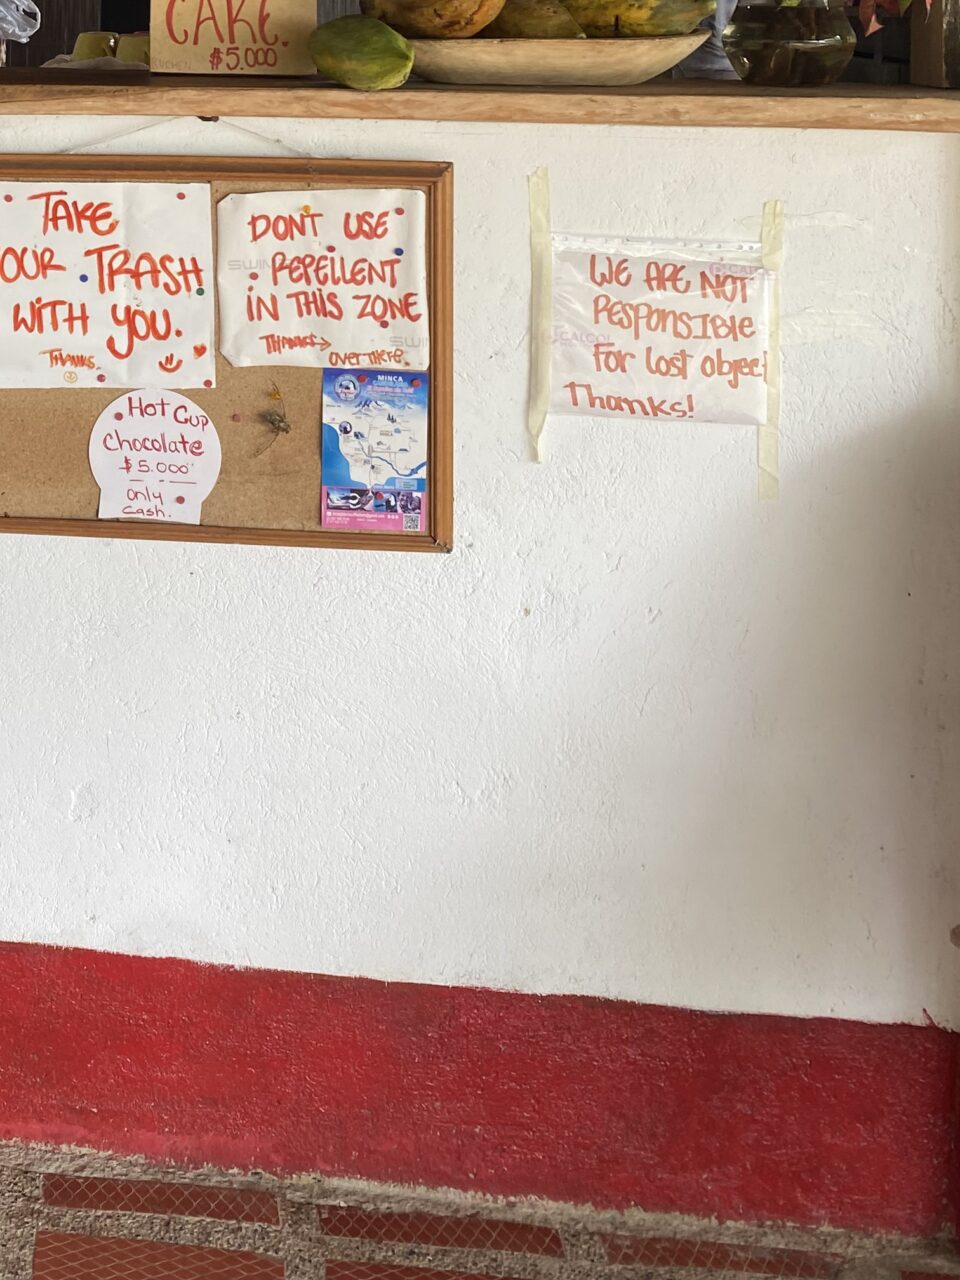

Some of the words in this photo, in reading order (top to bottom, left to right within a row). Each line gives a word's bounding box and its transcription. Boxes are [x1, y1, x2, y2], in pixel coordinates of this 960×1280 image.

[27, 190, 120, 236] TAKE
[343, 211, 390, 240] USE
[84, 244, 204, 296] TRASH
[590, 254, 632, 288] WE
[643, 261, 691, 294] ARE
[700, 271, 754, 303] NOT
[13, 296, 90, 336] WITH
[247, 285, 280, 322] IN
[286, 288, 344, 321] THIS
[352, 292, 422, 322] ZONE
[593, 342, 636, 373] For
[128, 396, 170, 418] Hot
[173, 405, 209, 432] Cup
[562, 381, 694, 418] Thanks!
[103, 429, 205, 456] Chocolate
[127, 487, 164, 505] only
